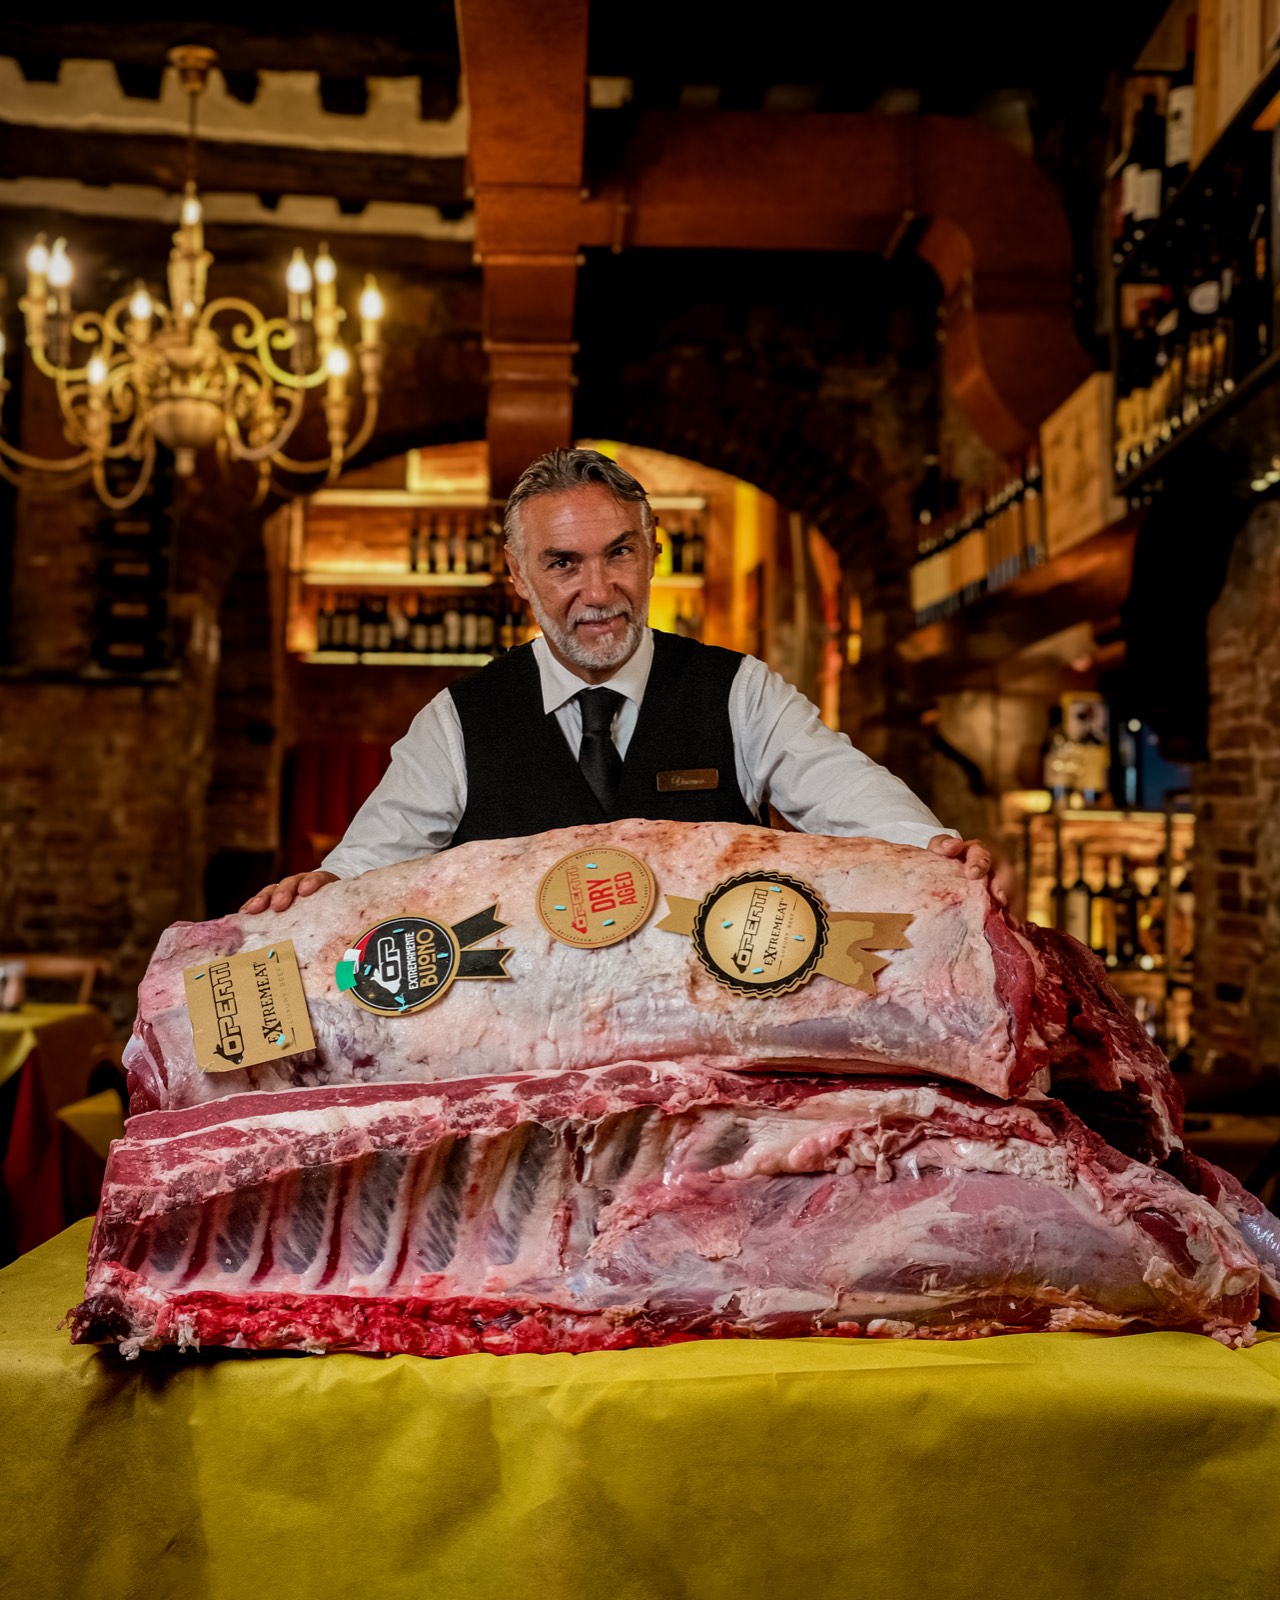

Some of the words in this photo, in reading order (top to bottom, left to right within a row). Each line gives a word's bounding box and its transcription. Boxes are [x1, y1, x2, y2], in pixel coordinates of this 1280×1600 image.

[586, 878, 617, 913] DRY
[614, 871, 638, 906] AGED
[764, 900, 788, 966] EXTREMEAT
[404, 931, 419, 990] EXTREMAMENTE
[416, 928, 438, 988] BUONO
[277, 967, 287, 987] BEEF
[282, 992, 294, 1025] LUXURY
